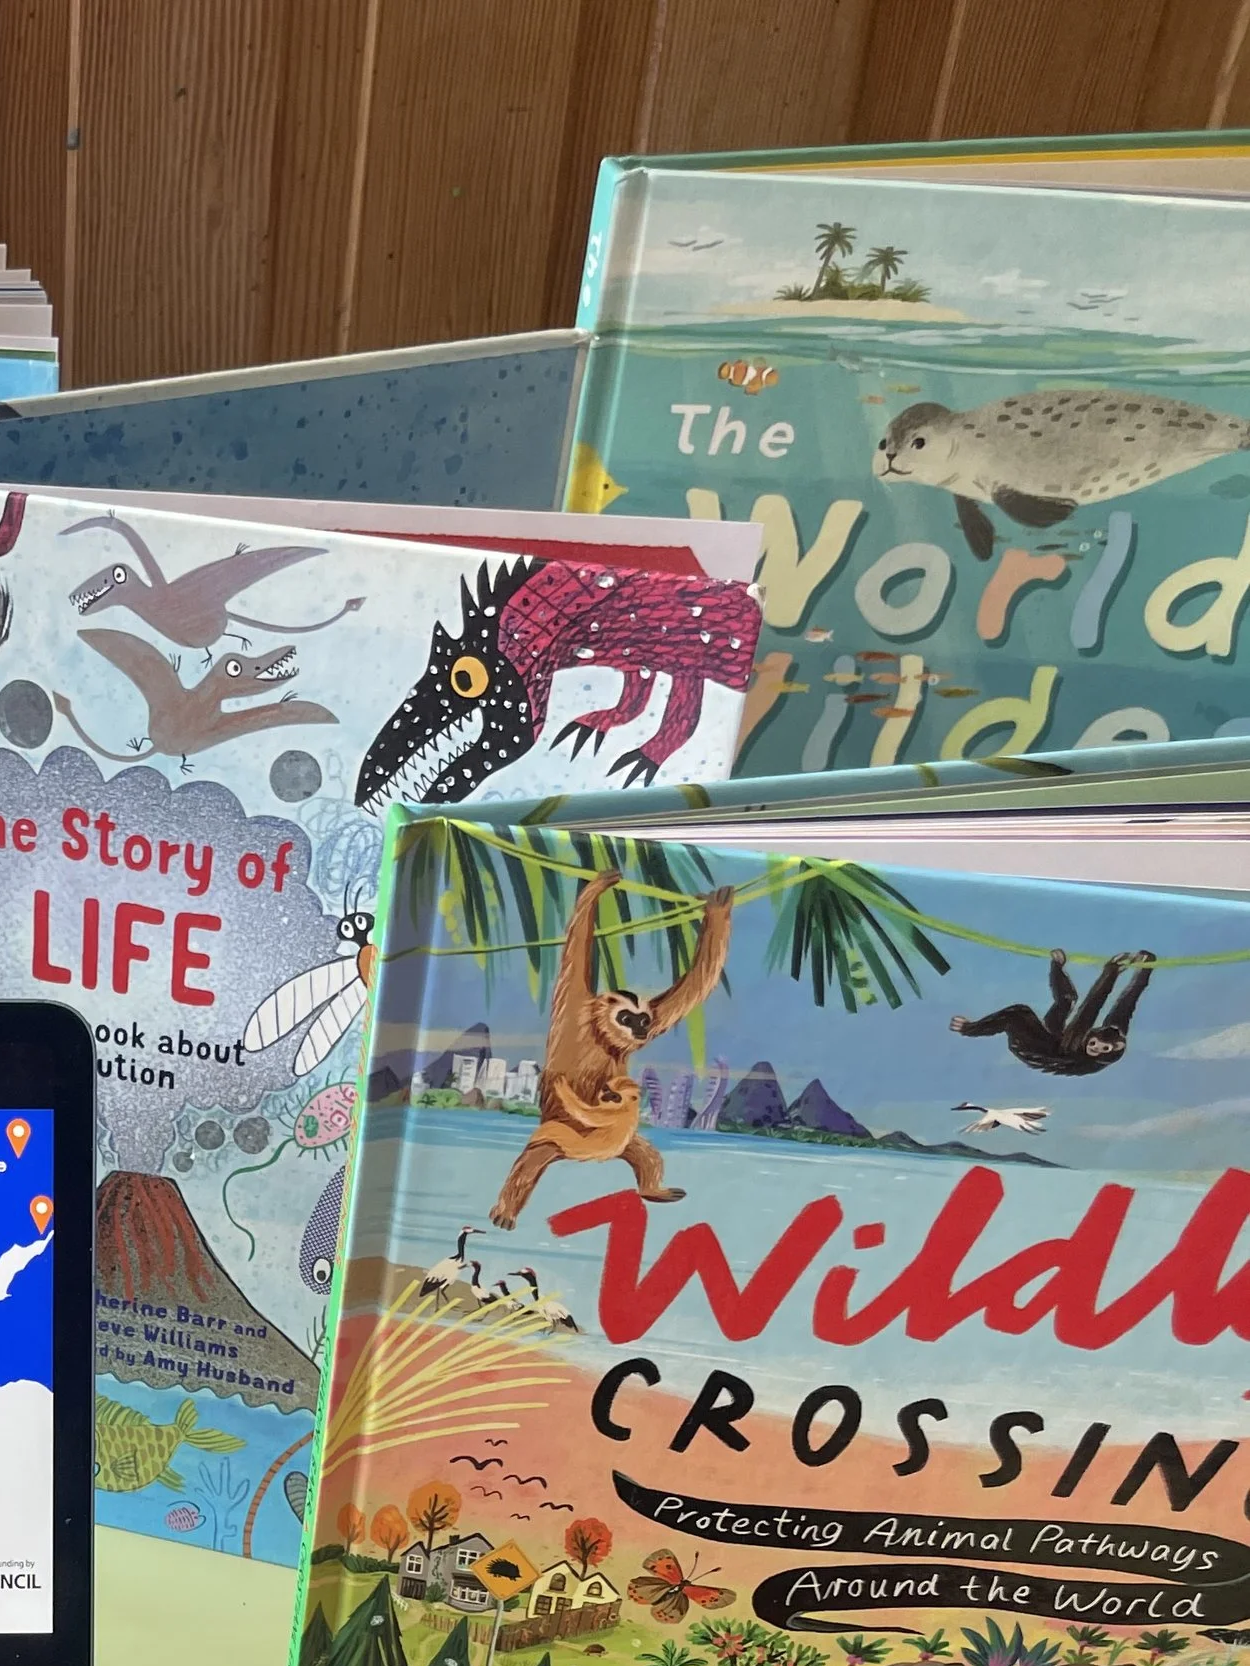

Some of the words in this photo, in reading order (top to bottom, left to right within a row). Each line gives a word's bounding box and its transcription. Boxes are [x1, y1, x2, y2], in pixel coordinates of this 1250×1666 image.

[669, 404, 796, 459] The
[61, 807, 214, 896] Story
[237, 841, 293, 892] of
[32, 890, 222, 1006] LIFE
[95, 1022, 145, 1049] ook
[158, 1029, 245, 1066] about
[97, 1054, 174, 1089] ution
[548, 1165, 1250, 1350] Wildl
[95, 1290, 168, 1319] herine
[177, 1306, 227, 1330] Barr
[234, 1323, 267, 1339] and
[98, 1321, 135, 1338] eve
[144, 1324, 239, 1359] Williams
[115, 1350, 135, 1366] by
[143, 1350, 189, 1377] Amy
[197, 1361, 295, 1395] Husband
[590, 1358, 1250, 1512] CROSSIN
[653, 1496, 843, 1547] Protecting
[863, 1517, 1013, 1553] Animal
[1030, 1525, 1219, 1574] Pathways
[26, 1560, 35, 1569] by
[786, 1569, 938, 1606] Around
[959, 1578, 1030, 1606] the
[1053, 1585, 1205, 1620] World
